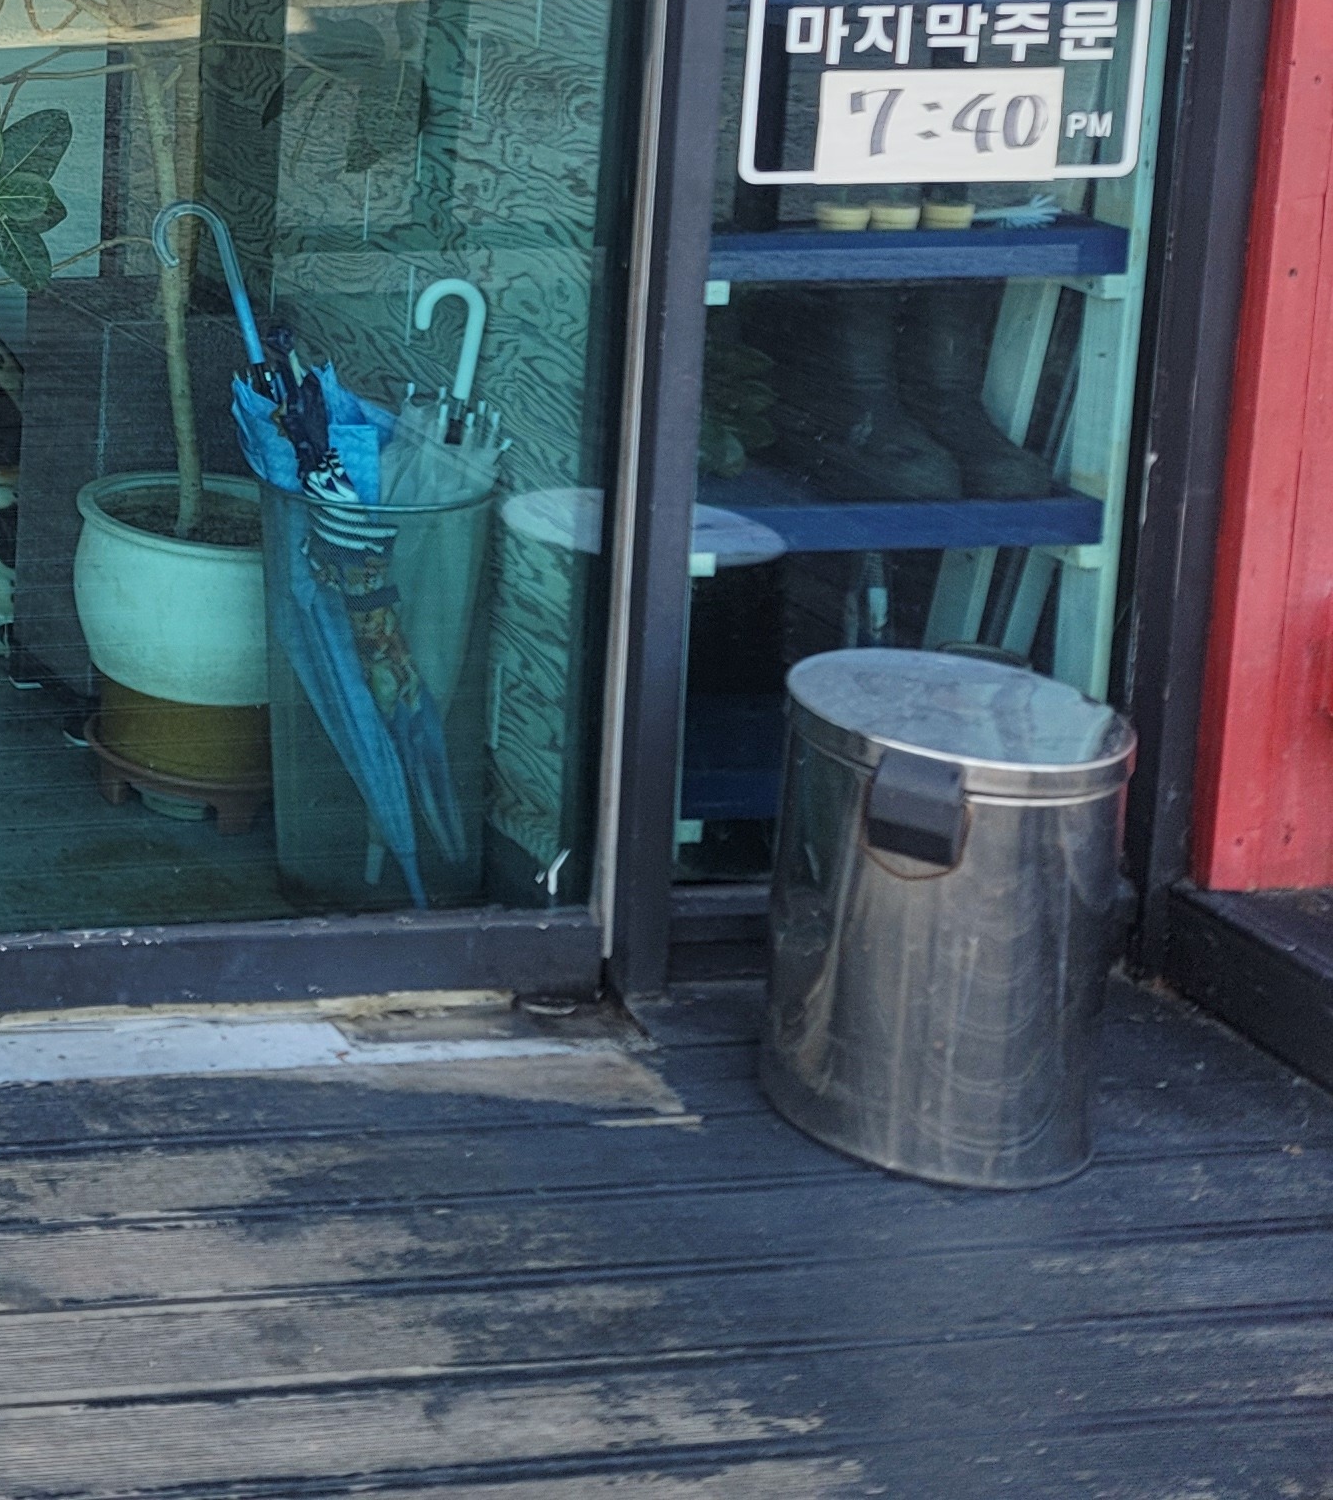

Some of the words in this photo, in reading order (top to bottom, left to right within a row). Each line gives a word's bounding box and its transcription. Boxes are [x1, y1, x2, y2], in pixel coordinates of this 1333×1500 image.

[784, 0, 1119, 66] 마지막주문
[849, 87, 1050, 158] 7:40
[1064, 110, 1113, 139] PM
